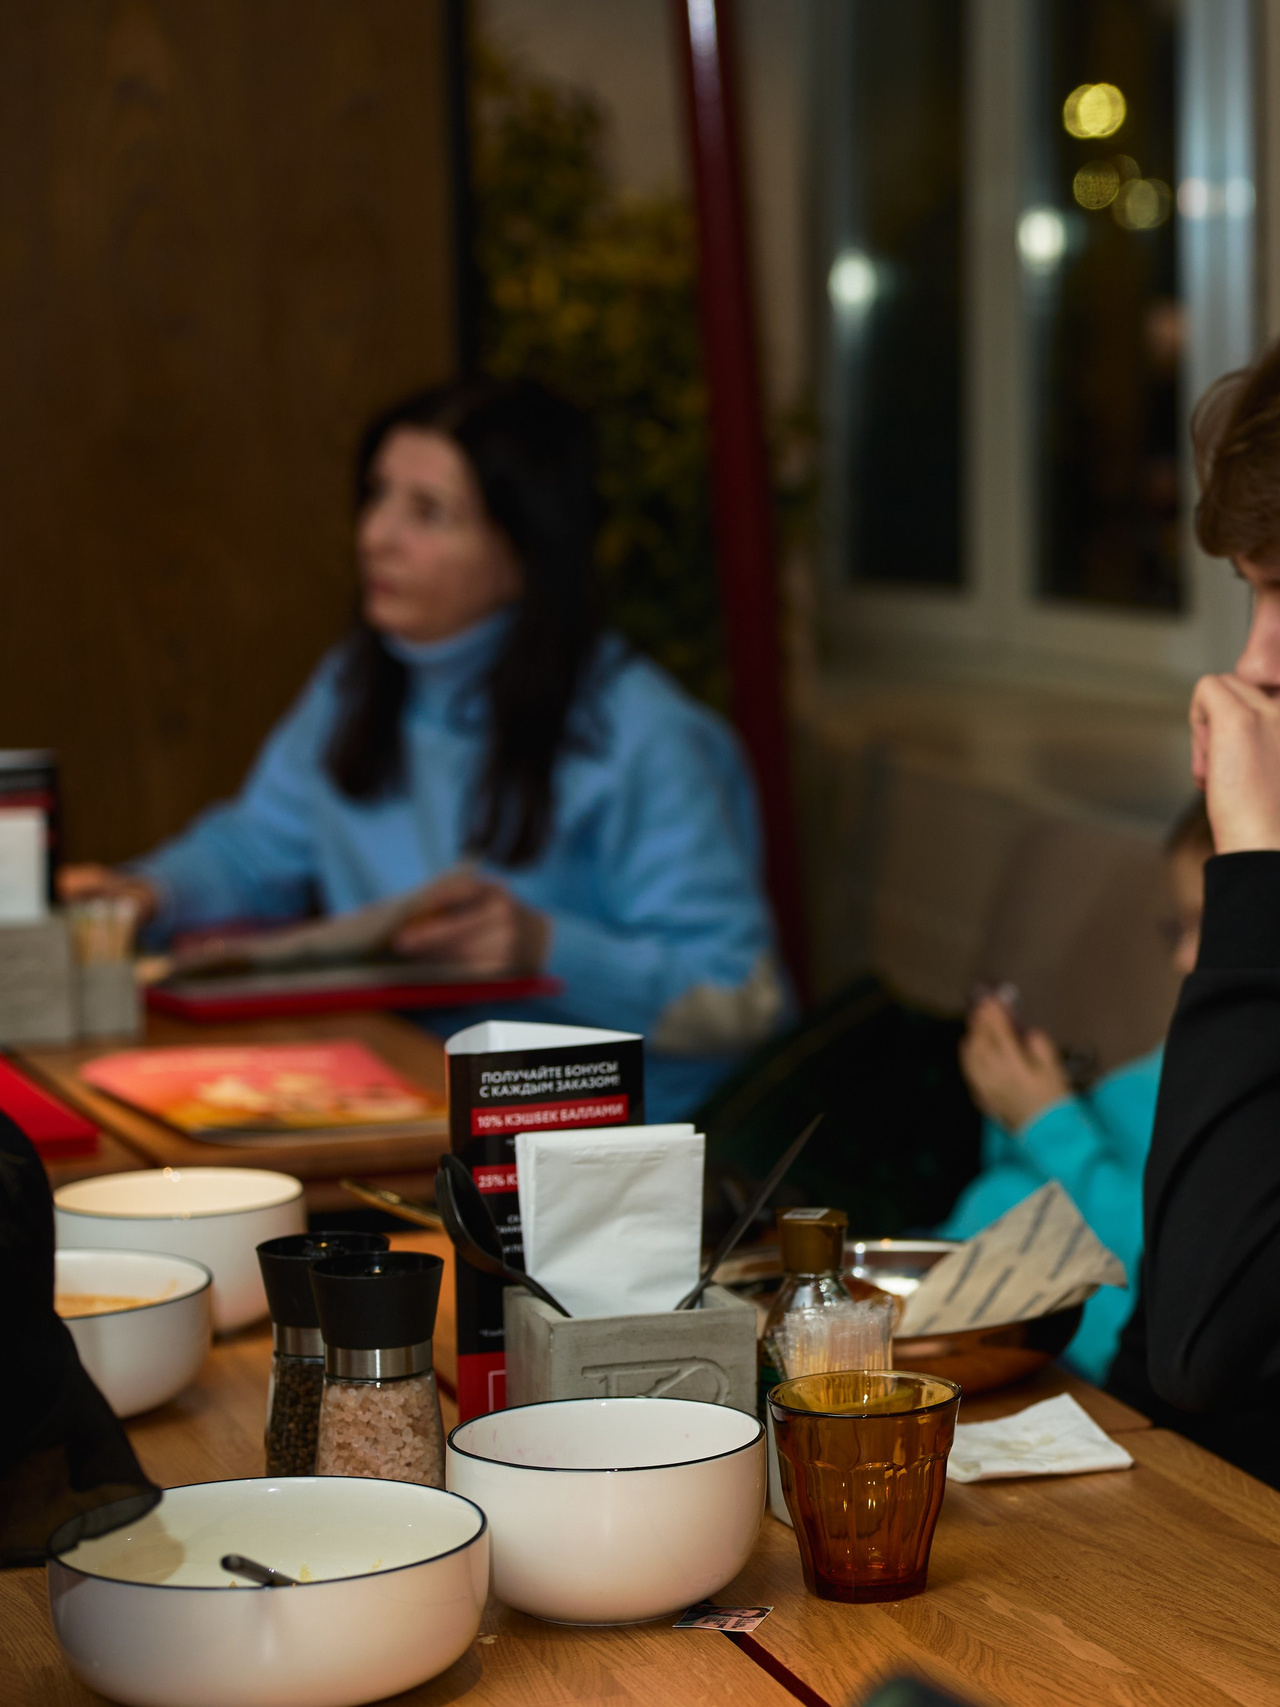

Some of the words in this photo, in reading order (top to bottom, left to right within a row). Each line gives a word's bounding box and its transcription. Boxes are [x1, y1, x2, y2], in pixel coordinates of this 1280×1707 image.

[481, 1066, 562, 1084] ПОЛУЧАЙТЕ
[564, 1061, 618, 1076] БОНУСЫ
[479, 1086, 491, 1098] С
[491, 1081, 554, 1097] КАЖДЫМ
[556, 1075, 621, 1092] ЗАКАЗОМ!
[477, 1115, 503, 1128] 10%
[505, 1110, 558, 1126] КЭШБЕК
[560, 1103, 624, 1120] БАЛЛАМИ
[478, 1174, 505, 1188] 25%
